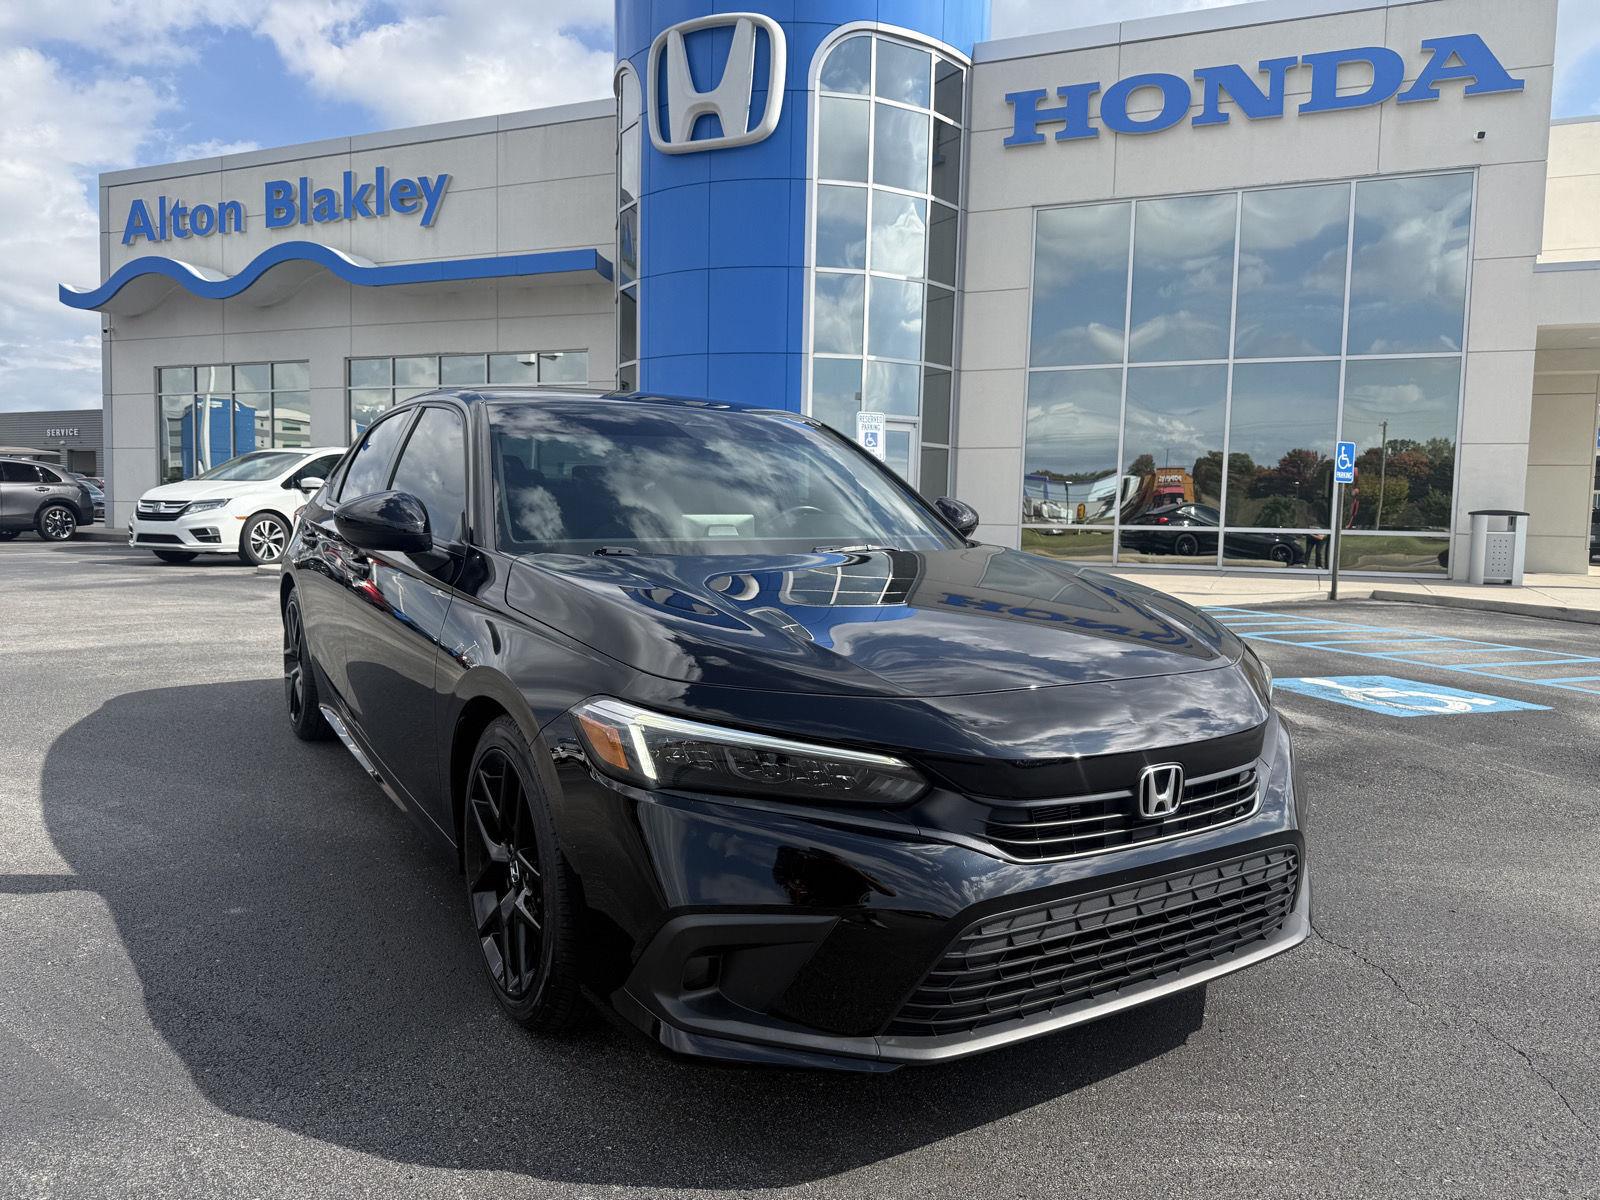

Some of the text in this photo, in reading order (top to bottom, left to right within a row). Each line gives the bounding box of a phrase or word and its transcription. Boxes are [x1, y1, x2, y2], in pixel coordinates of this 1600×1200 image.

[1002, 33, 1525, 148] HONDA
[121, 166, 451, 246] Alton Blakley
[859, 415, 882, 423] RESERVED
[861, 423, 881, 431] PARKING
[46, 428, 79, 437] SERVICE
[1336, 471, 1352, 479] PARKING
